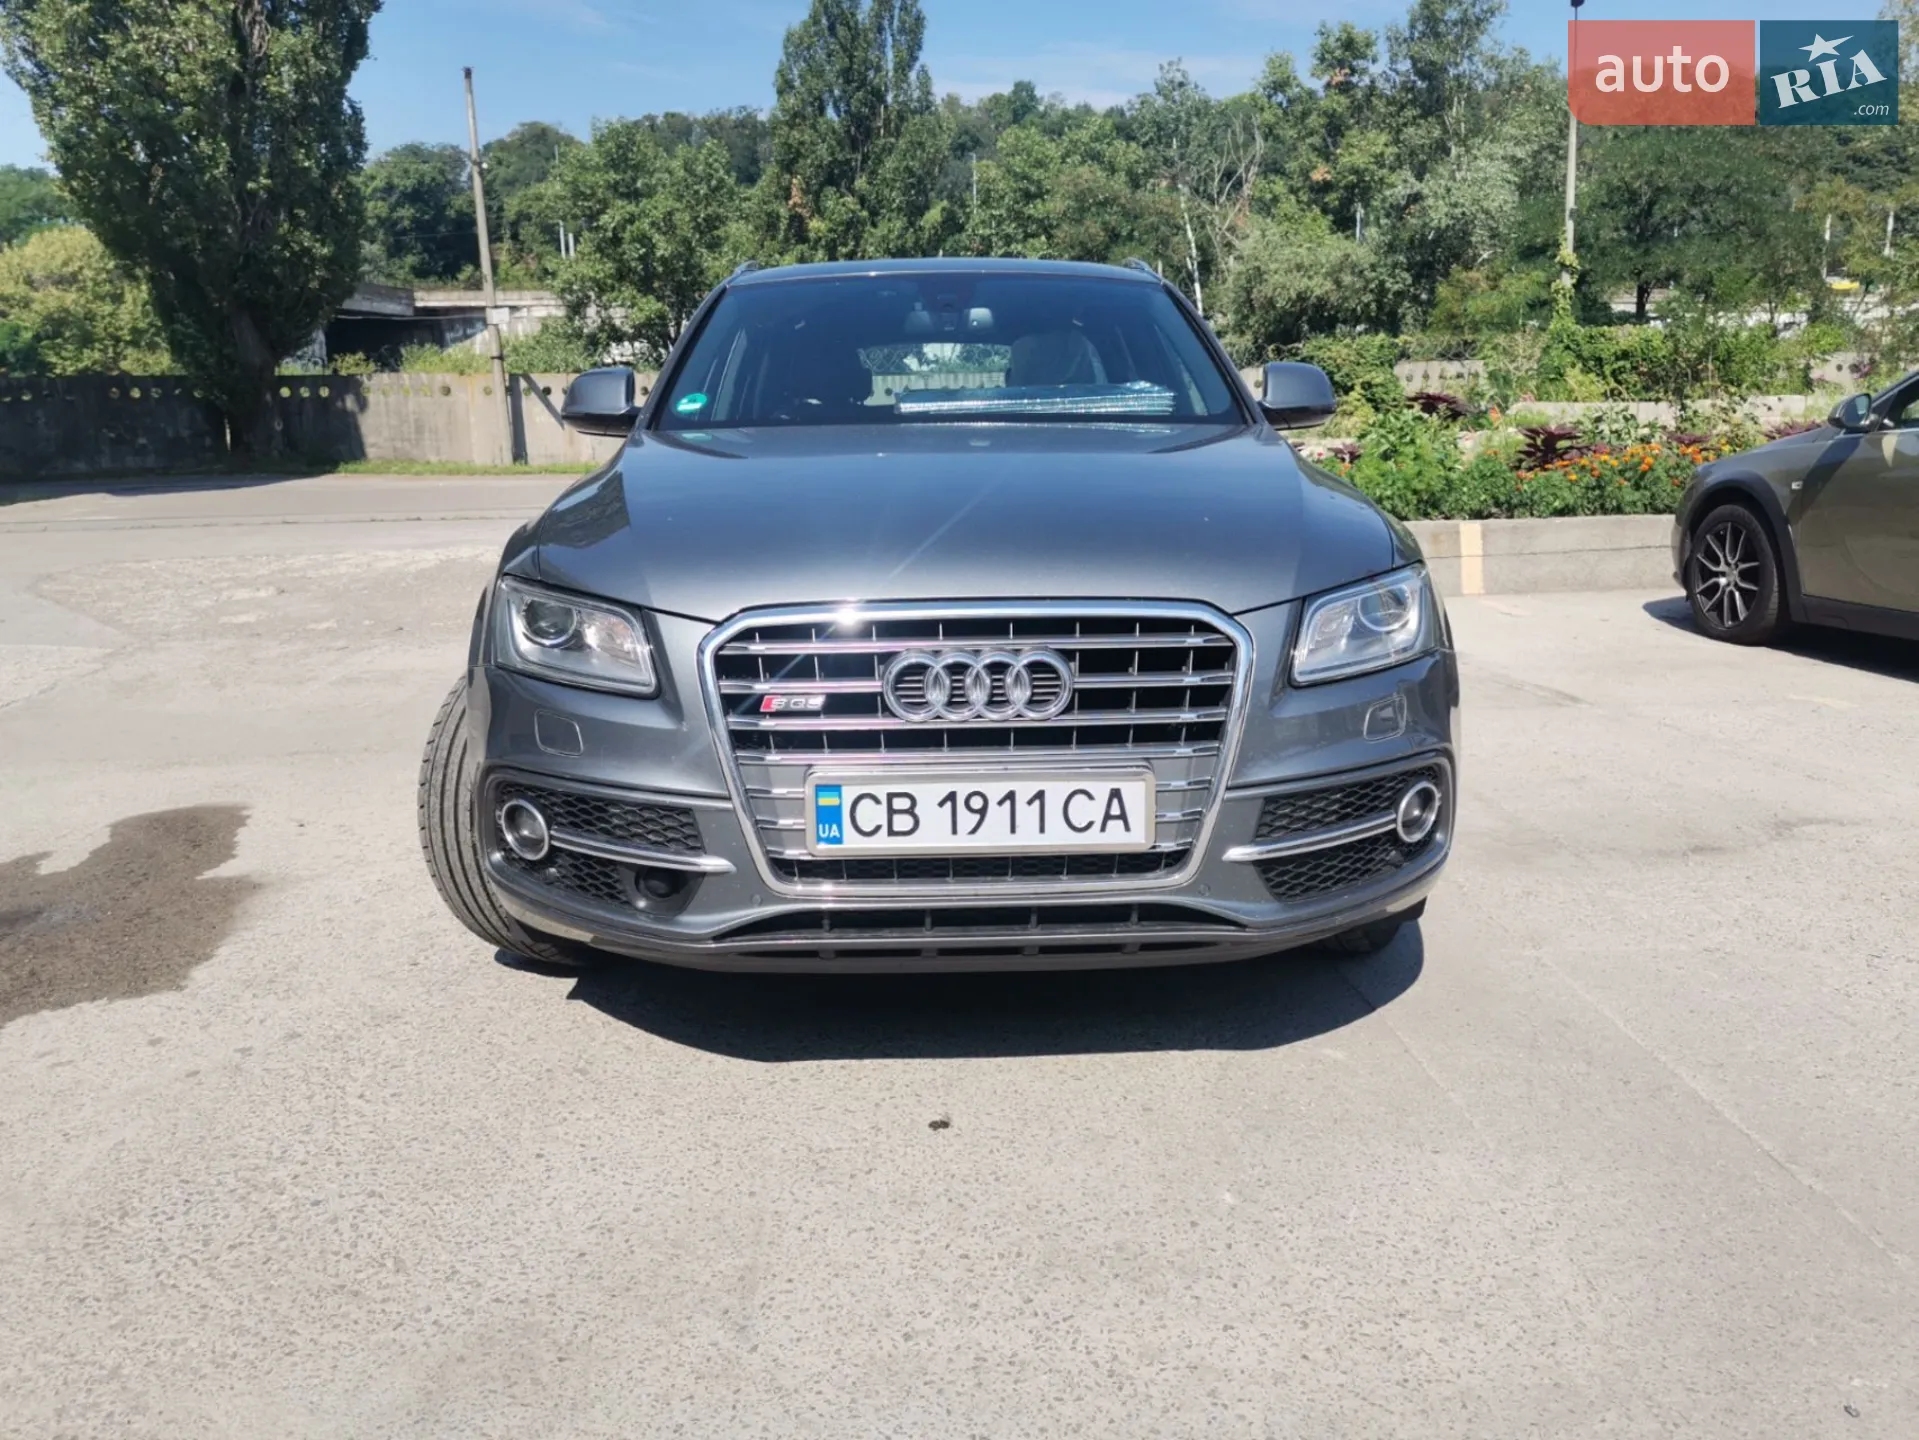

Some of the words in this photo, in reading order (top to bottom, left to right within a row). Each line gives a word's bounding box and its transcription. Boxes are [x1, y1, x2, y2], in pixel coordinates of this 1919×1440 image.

[850, 792, 920, 838] CB
[937, 789, 1046, 835] 1911
[1063, 788, 1131, 833] CA
[818, 824, 840, 838] UA
